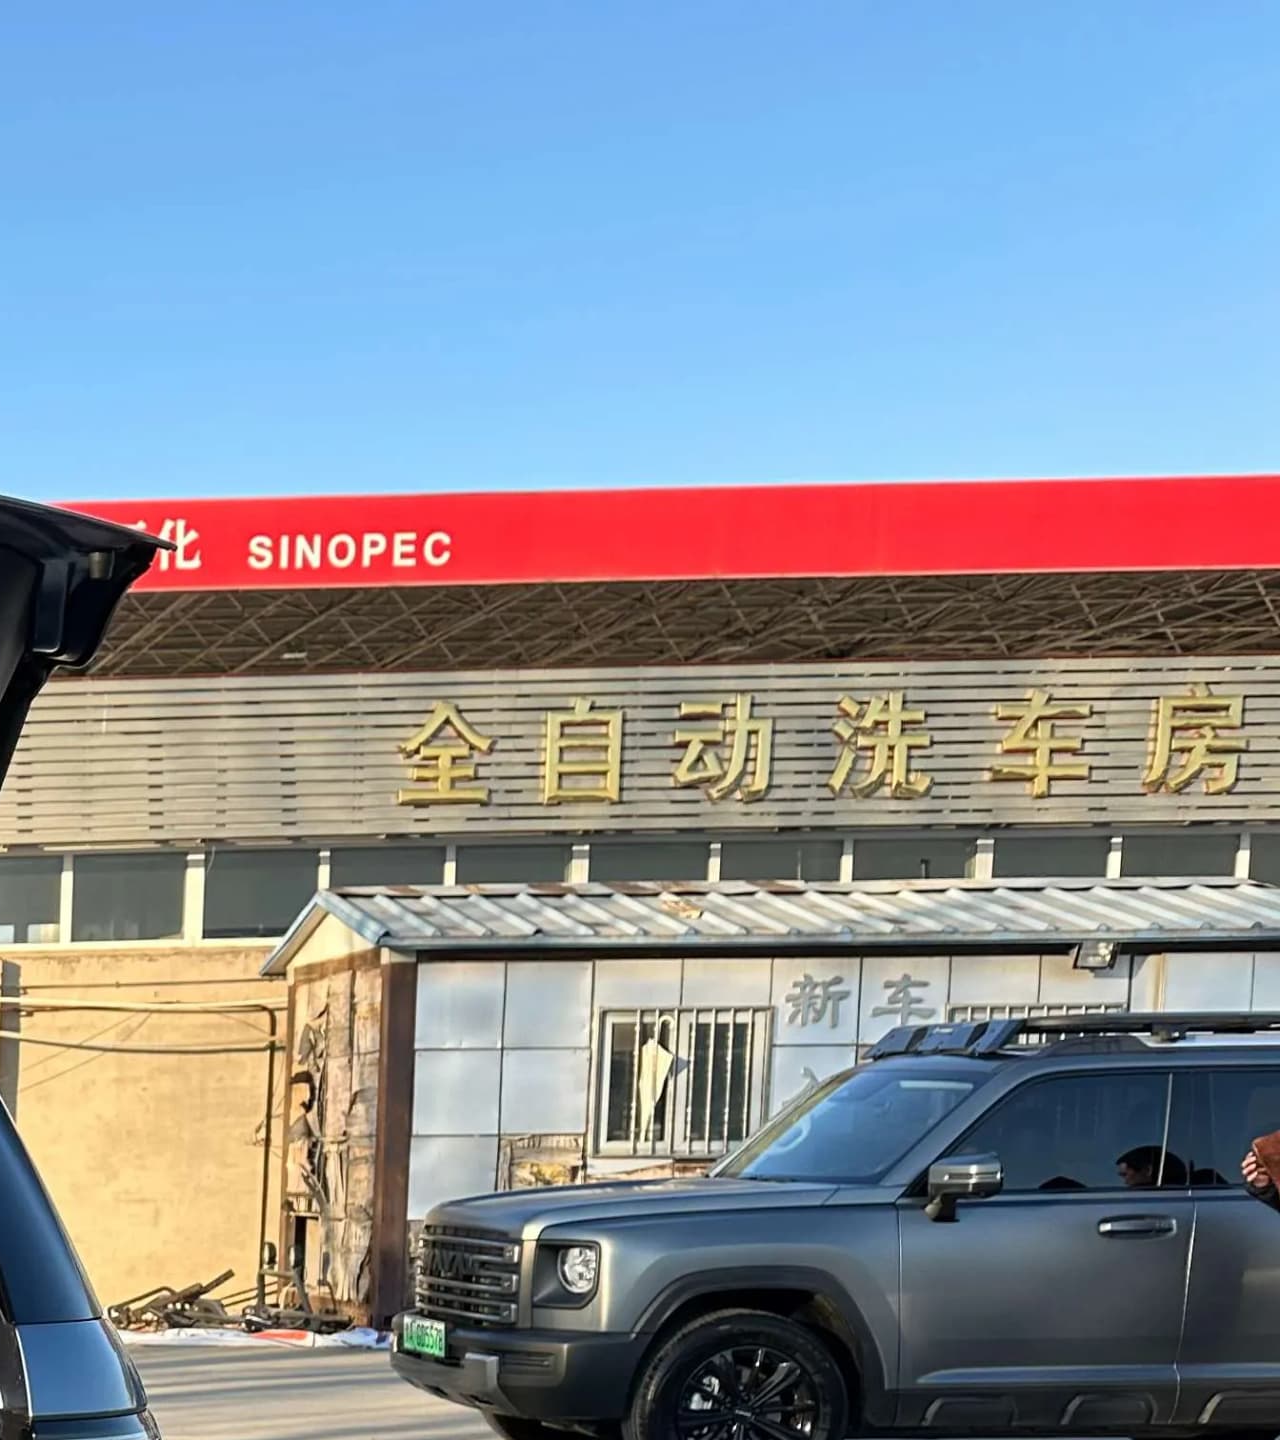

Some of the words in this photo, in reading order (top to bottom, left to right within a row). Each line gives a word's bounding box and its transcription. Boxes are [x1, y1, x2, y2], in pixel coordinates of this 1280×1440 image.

[247, 532, 452, 569] SINOPEC
[397, 684, 1248, 806] 全自动洗车房
[785, 973, 936, 1029] 新车
